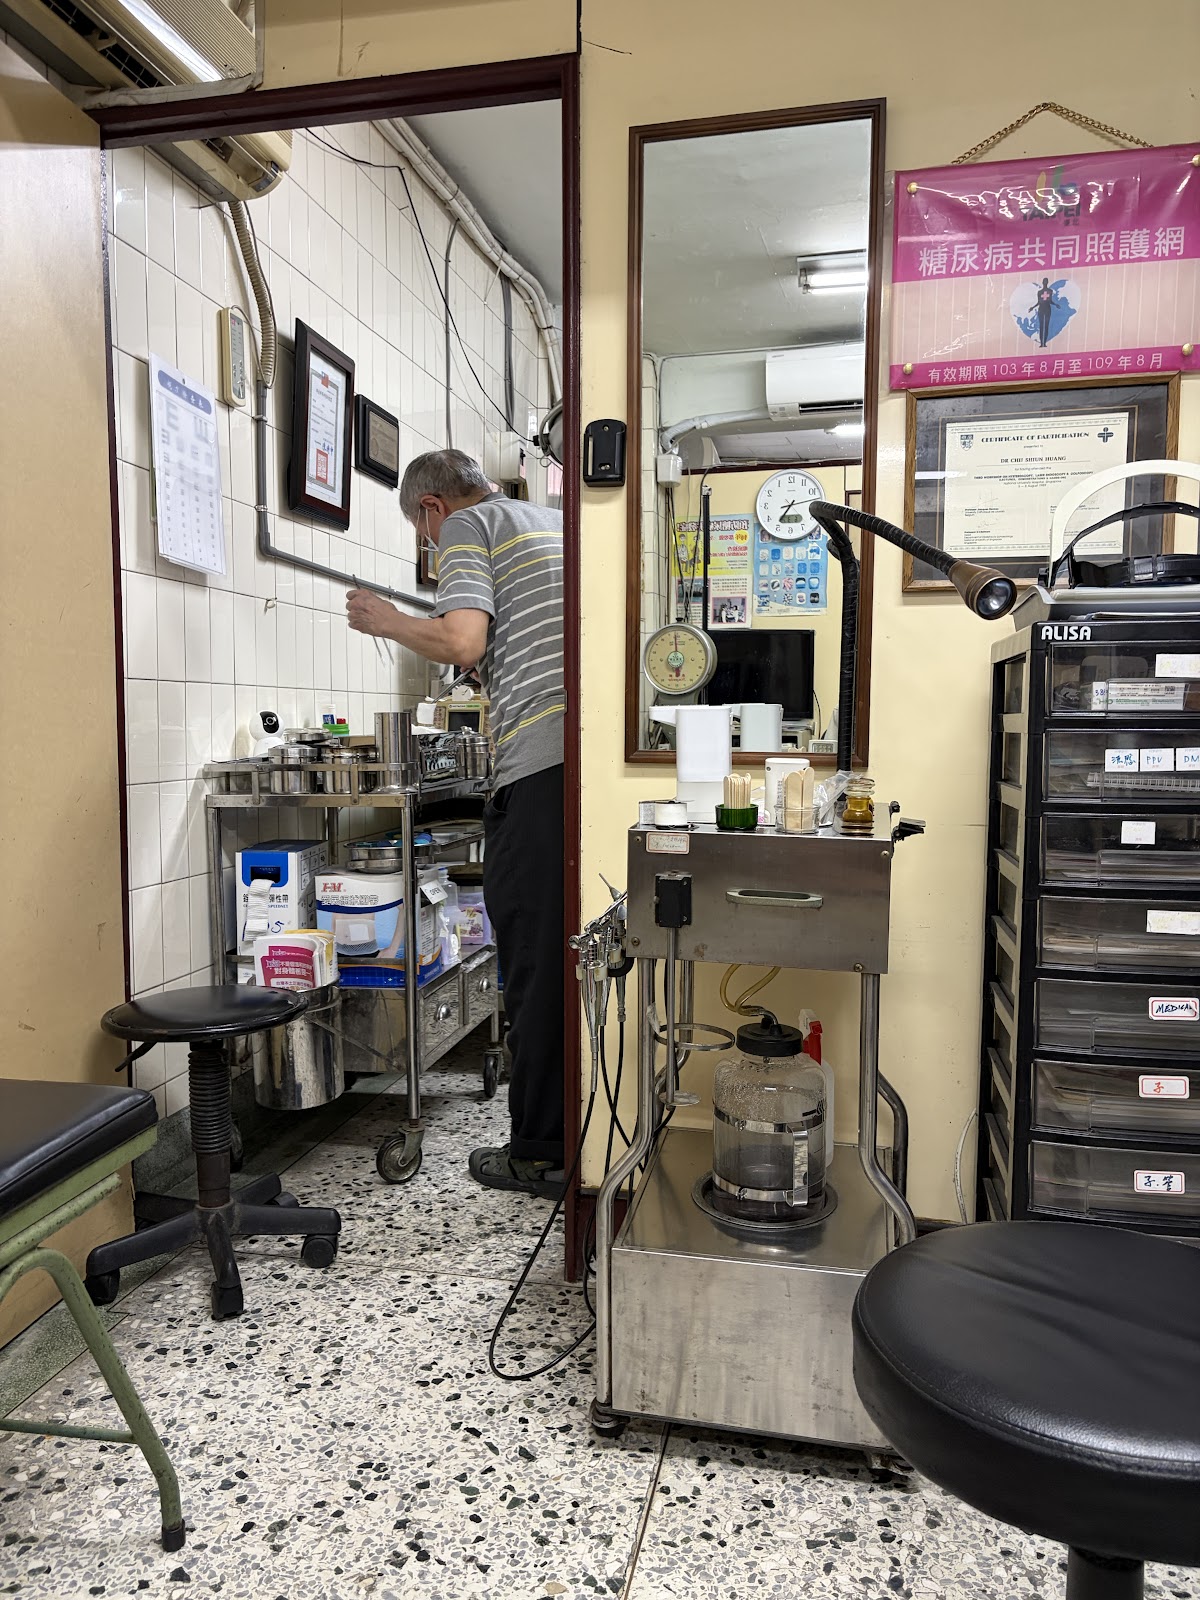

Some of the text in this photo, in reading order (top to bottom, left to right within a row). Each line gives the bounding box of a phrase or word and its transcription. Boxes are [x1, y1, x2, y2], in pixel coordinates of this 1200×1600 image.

[918, 226, 1186, 278] 糖尿病共同照護網
[981, 435, 1024, 443] CERTIFICATE
[1037, 432, 1090, 440] PARTICIPATION
[1041, 626, 1092, 640] ALISA
[1146, 755, 1162, 765] PPV
[429, 886, 442, 896] OPEN
